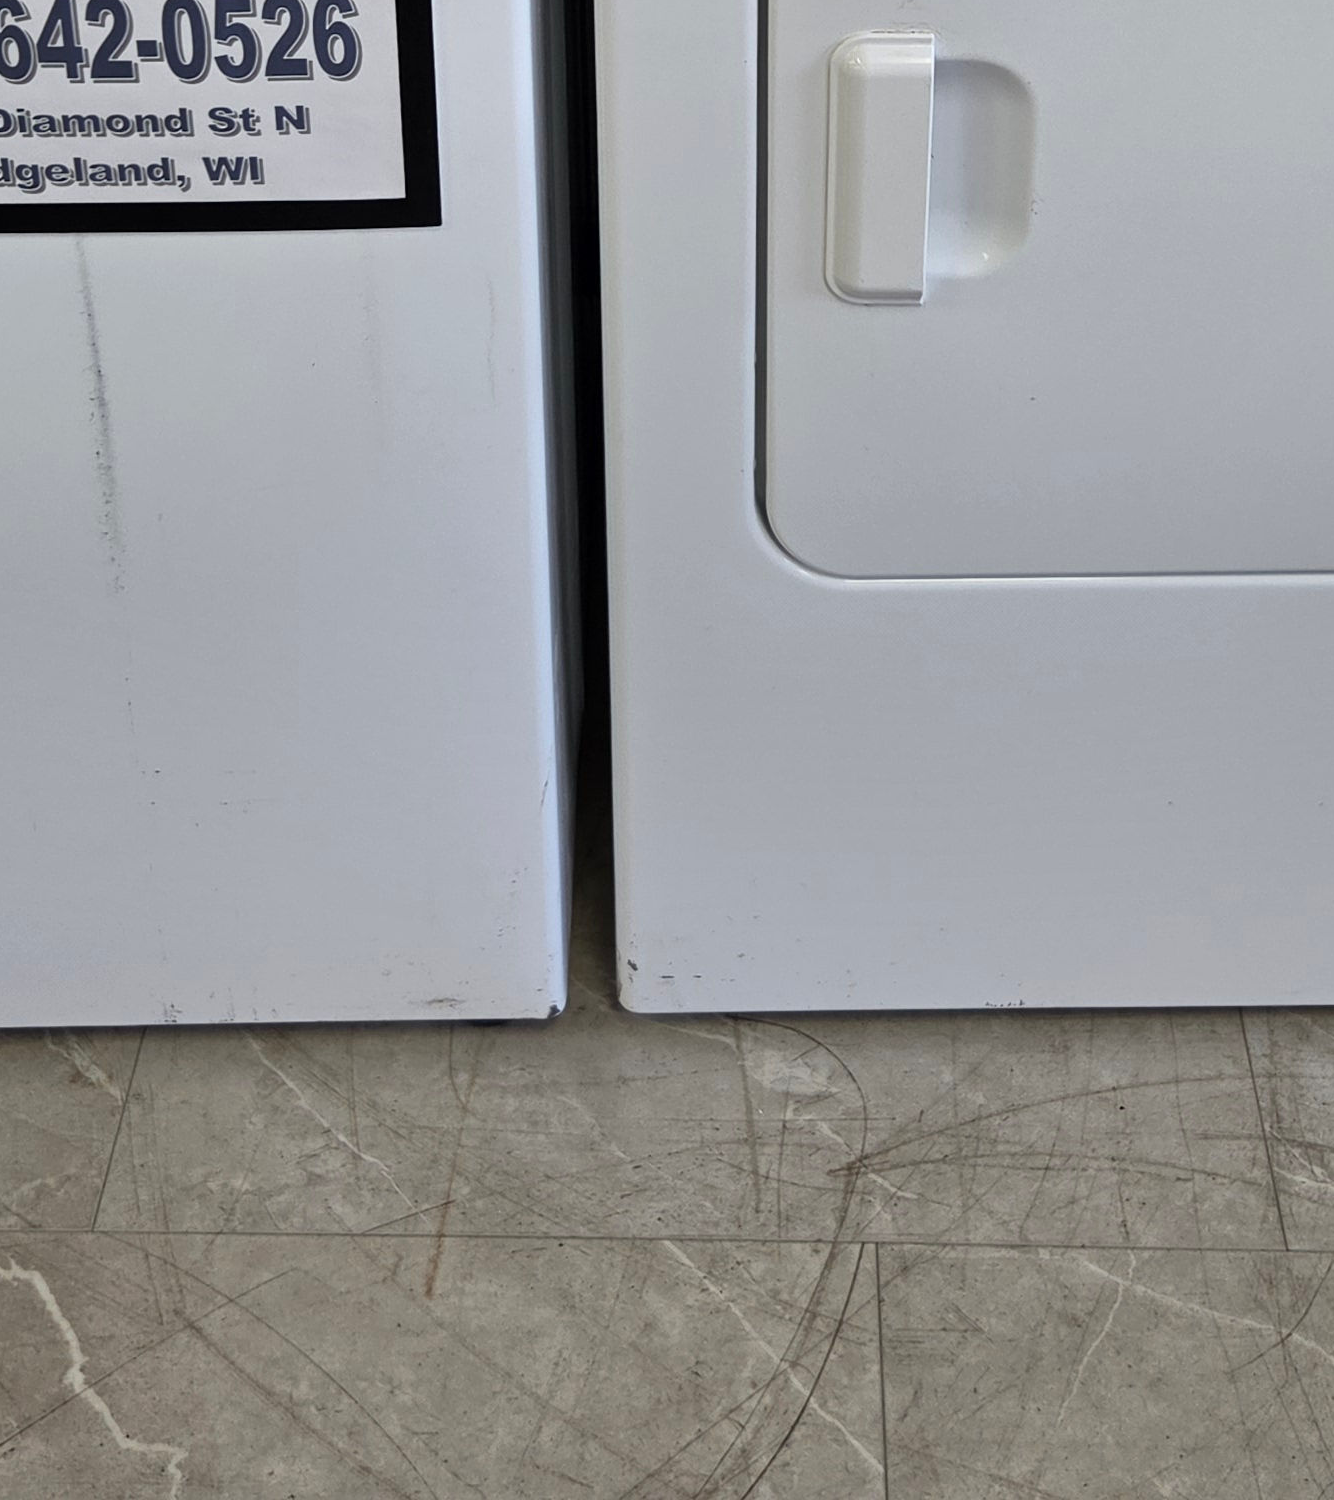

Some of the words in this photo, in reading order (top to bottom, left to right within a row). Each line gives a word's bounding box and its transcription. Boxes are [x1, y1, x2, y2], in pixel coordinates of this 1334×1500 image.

[207, 105, 262, 137] St
[274, 104, 311, 135] N
[202, 156, 266, 187] WI
